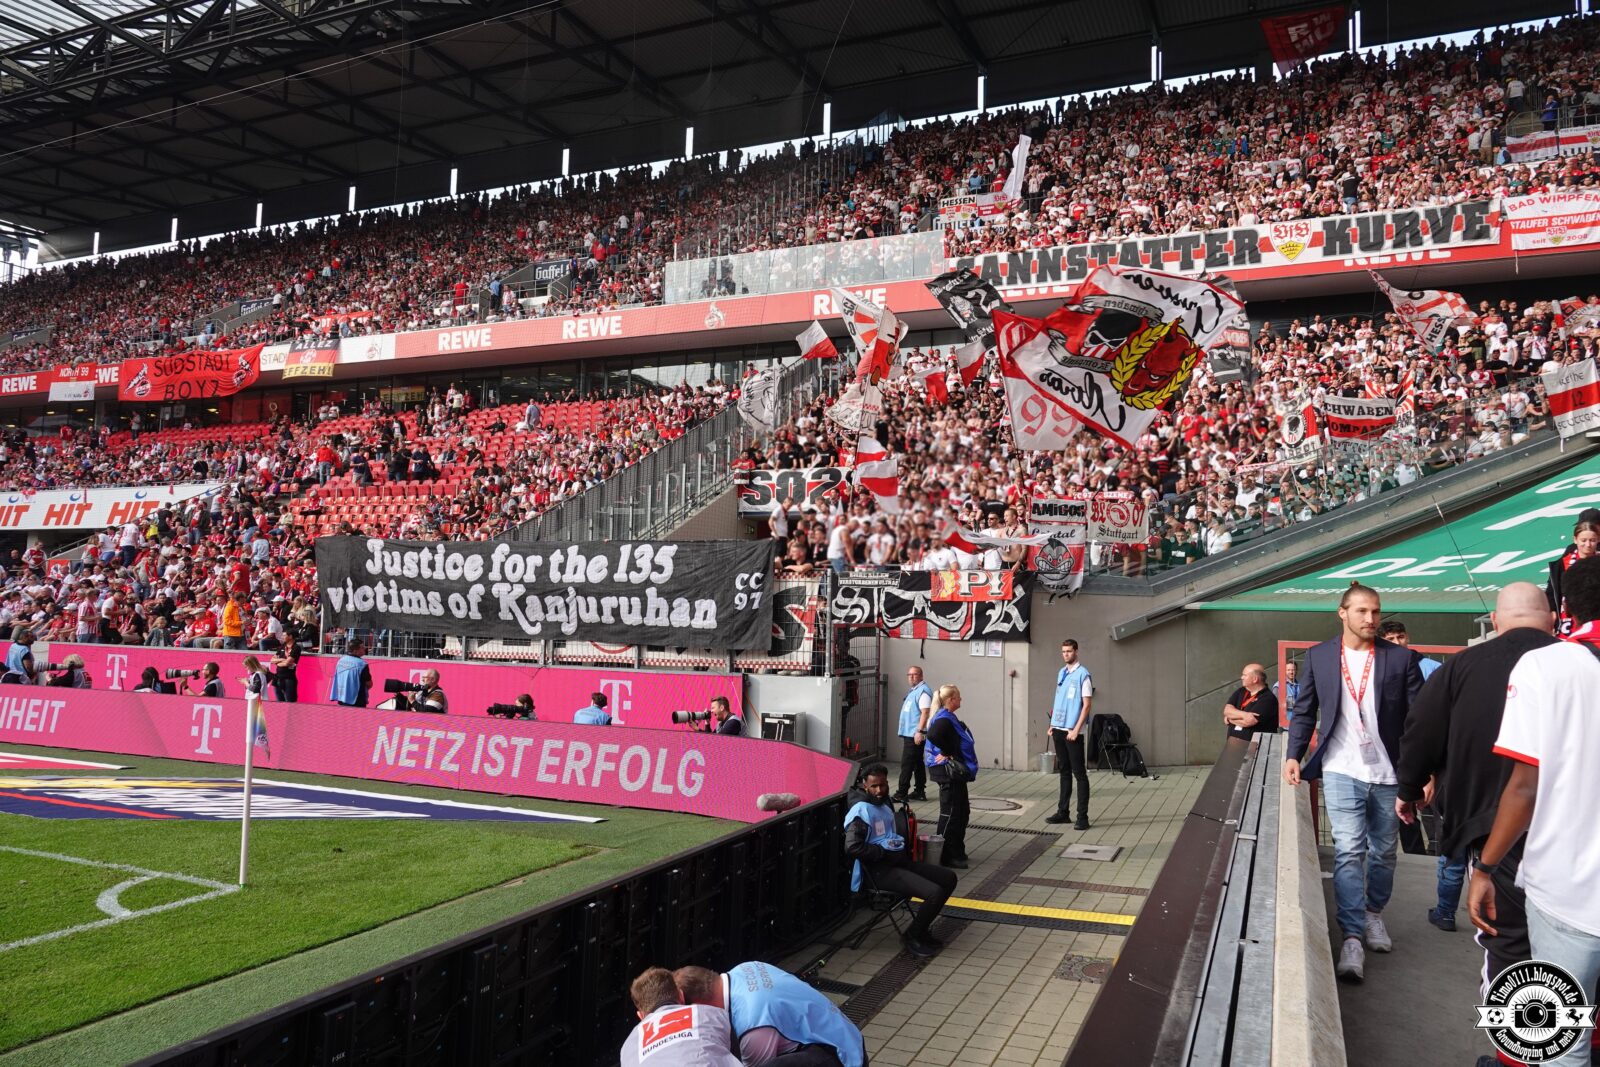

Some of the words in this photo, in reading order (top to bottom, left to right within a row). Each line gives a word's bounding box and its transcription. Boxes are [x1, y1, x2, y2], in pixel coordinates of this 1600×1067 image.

[942, 196, 976, 208] HESSEN
[1508, 198, 1535, 212] BAD
[1538, 193, 1600, 204] WIMPFEN
[1322, 199, 1491, 256] KURVE
[1510, 218, 1549, 230] STAUFER
[562, 316, 623, 339] REWE
[295, 340, 333, 350] ALLEZ
[438, 328, 492, 351] REWE
[2, 375, 37, 393] REWE
[95, 366, 119, 383] WE
[164, 380, 219, 399] BOYZ
[1323, 402, 1393, 416] CHWABEN
[0, 505, 30, 526] IT
[42, 503, 93, 526] HIT
[106, 501, 160, 525] HIT
[1096, 524, 1138, 542] Stuttgart
[365, 538, 485, 582] Justice
[488, 543, 544, 583] for
[549, 544, 609, 584] the
[613, 543, 679, 584] 135
[1318, 548, 1566, 579] DEV
[735, 572, 765, 590] CC
[327, 576, 446, 617] victims
[447, 583, 486, 620] of
[491, 582, 718, 636] Kanjuruhan
[734, 592, 763, 611] 97
[0, 697, 66, 733] IHEIT
[372, 726, 467, 773] NETZ
[471, 734, 533, 777] IST
[536, 738, 706, 797] ERFOLG
[642, 1031, 693, 1056] BUNDESLIGA
